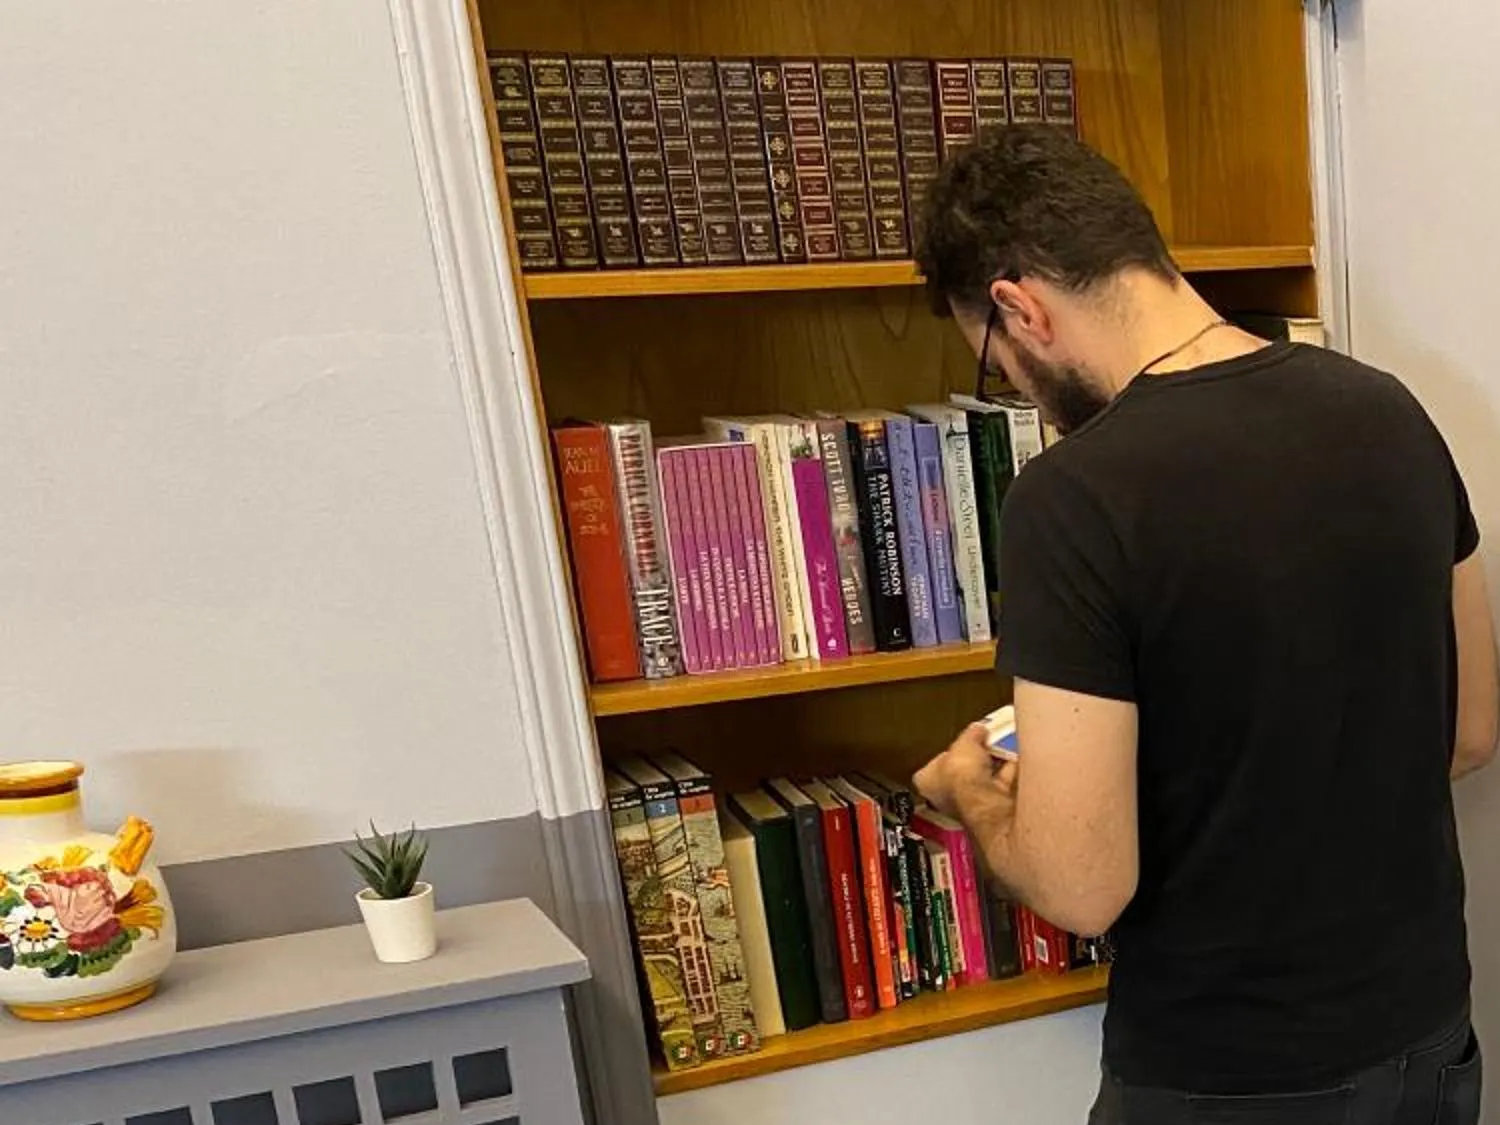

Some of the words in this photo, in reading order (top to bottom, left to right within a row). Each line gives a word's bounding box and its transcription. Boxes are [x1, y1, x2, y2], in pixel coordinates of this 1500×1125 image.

[618, 434, 649, 499] PATRICIA
[821, 433, 843, 474] SCOTT
[954, 437, 970, 498] Danielle
[868, 476, 879, 499] THE
[877, 473, 894, 528] PATRICK
[628, 503, 660, 579] CORNWELL
[872, 503, 884, 545] SHARK
[960, 499, 975, 538] Steel
[878, 549, 893, 597] MUTINY
[885, 531, 903, 596] ROBINSON
[636, 585, 674, 647] TRACE
[841, 577, 864, 626] HEROES
